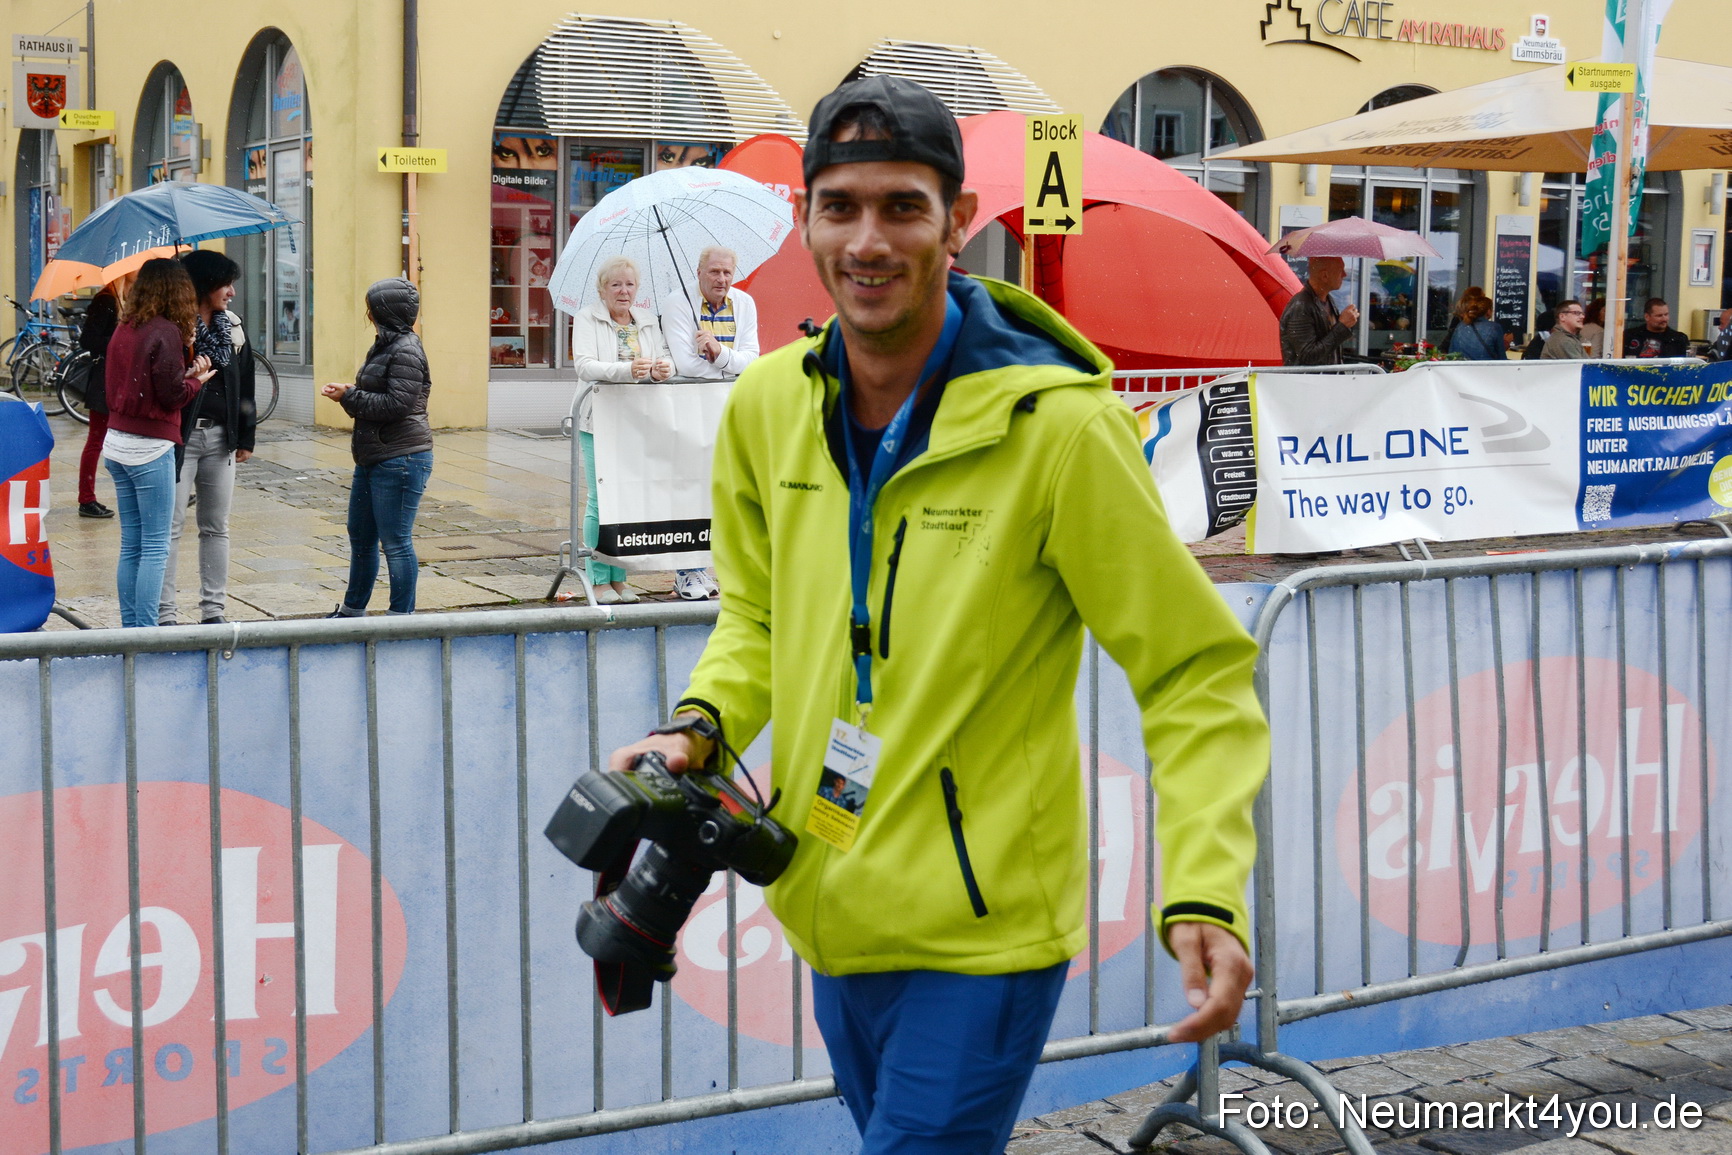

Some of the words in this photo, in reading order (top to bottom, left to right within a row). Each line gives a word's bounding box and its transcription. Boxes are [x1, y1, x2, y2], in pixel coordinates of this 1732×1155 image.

[1398, 19, 1428, 44] AM
[1431, 22, 1507, 50] RATHAUS
[19, 40, 65, 53] RATHAUS
[67, 44, 73, 53] II
[1523, 39, 1558, 49] Neumarkter
[1516, 47, 1563, 61] Lammsbräu
[1578, 66, 1634, 78] Startnummern-
[1590, 80, 1621, 91] ausgabe
[1033, 119, 1077, 140] Block
[393, 155, 437, 166] Toiletten
[492, 174, 523, 185] Digitale
[524, 176, 548, 185] Bilder
[1036, 151, 1070, 207] A
[1588, 385, 1618, 407] WIR
[1627, 385, 1704, 406] SUCHEN
[1586, 417, 1623, 433] FREIE
[1217, 428, 1242, 436] Wasser
[1586, 438, 1628, 453] UNTER
[1223, 470, 1246, 479] Freizeit
[1283, 489, 1329, 519] The
[1336, 491, 1391, 521] way
[1401, 484, 1432, 510] to
[1443, 485, 1475, 516] go.
[922, 507, 983, 517] Neumarkter
[921, 520, 969, 533] Stadtlauf
[616, 530, 696, 548] Leistungen,
